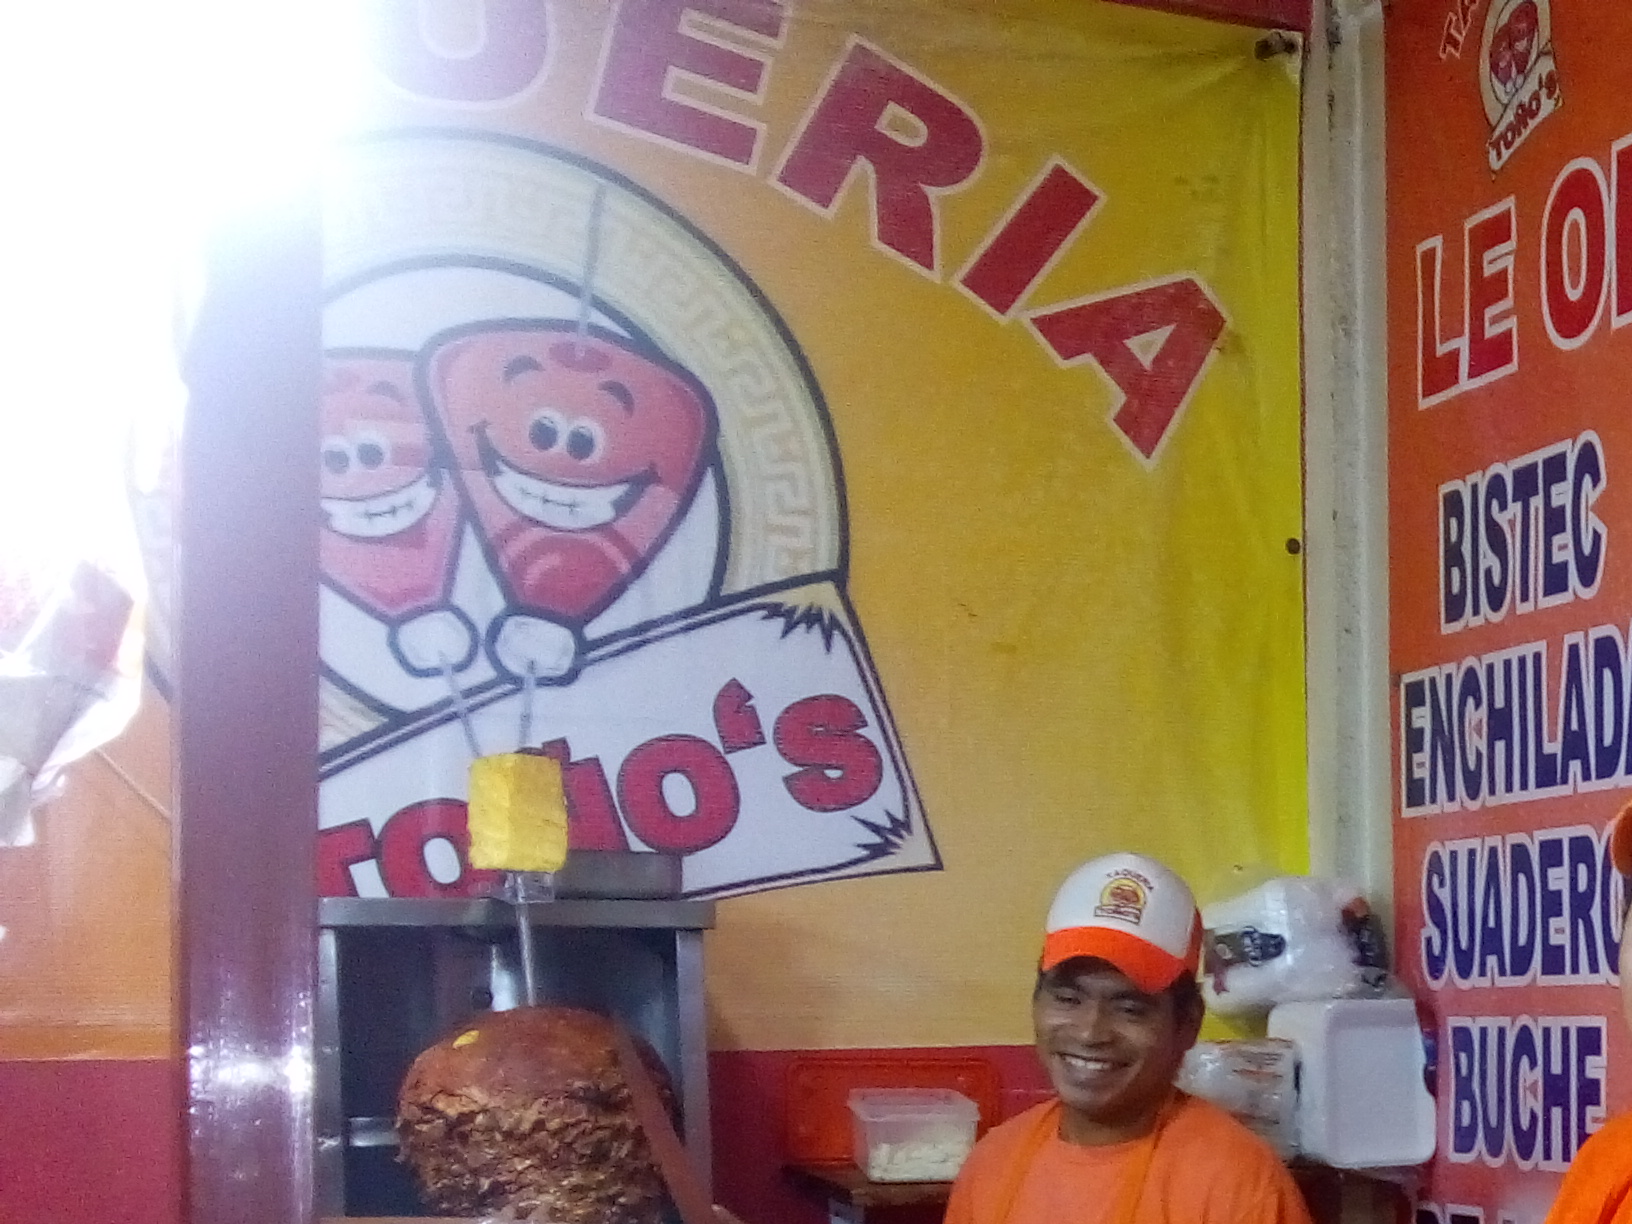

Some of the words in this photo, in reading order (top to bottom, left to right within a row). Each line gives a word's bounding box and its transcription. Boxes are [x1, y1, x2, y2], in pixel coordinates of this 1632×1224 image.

[1418, 200, 1517, 406] LE
[1440, 434, 1604, 628] BISTEC
[1452, 1022, 1604, 1166] BUCHE
